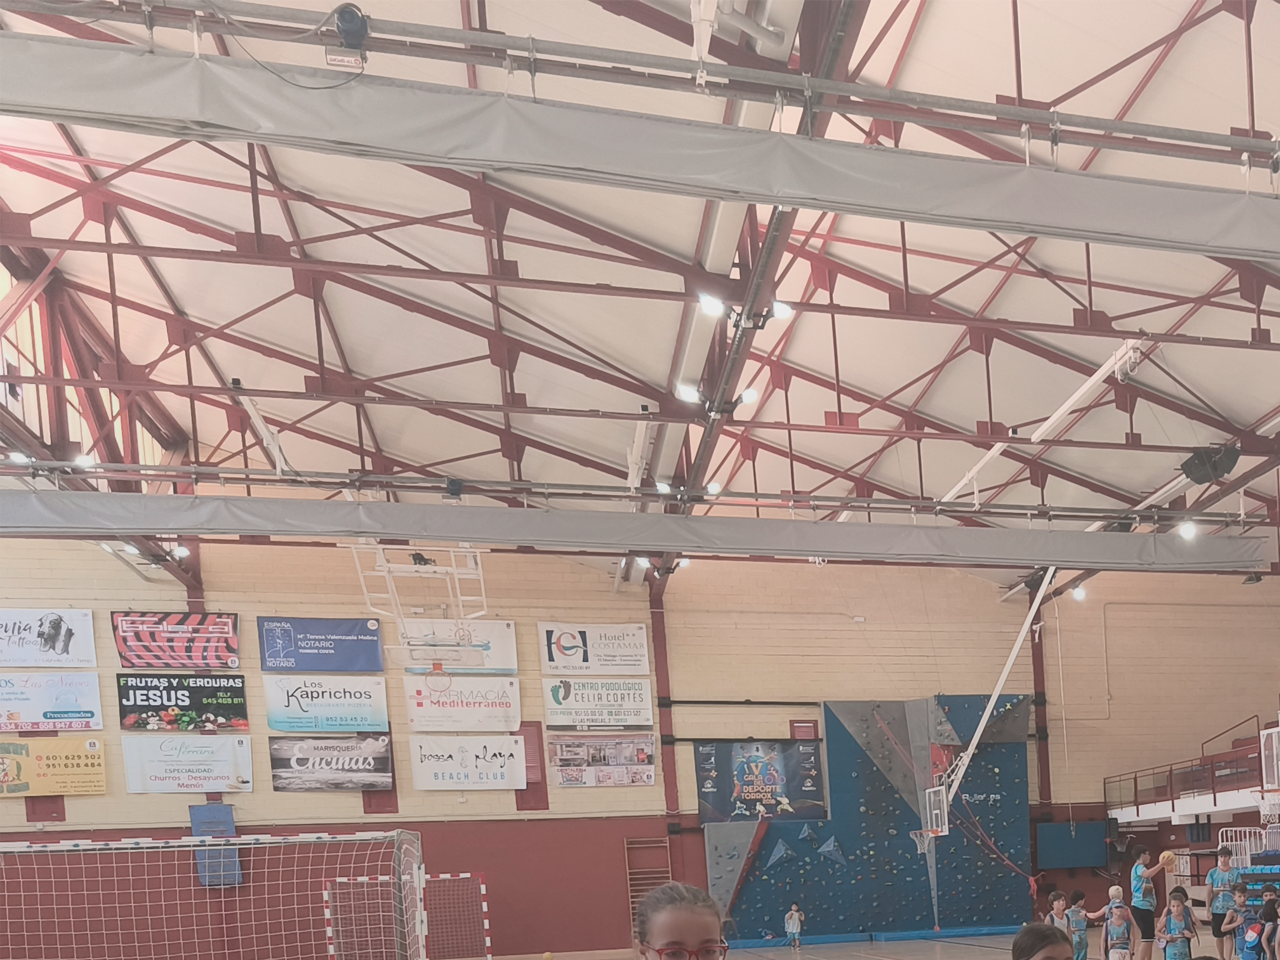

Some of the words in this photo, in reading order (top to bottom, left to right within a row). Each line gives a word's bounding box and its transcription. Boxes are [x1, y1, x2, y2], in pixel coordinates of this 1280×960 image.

[592, 642, 646, 650] COSTAMAR
[120, 677, 169, 688] FRUTAS
[171, 678, 179, 687] Y
[182, 678, 243, 688] VERDURAS
[303, 680, 324, 689] Los
[573, 682, 599, 691] CENTRO
[600, 680, 643, 692] PODOLÓGICO
[284, 686, 373, 713] Kaprichos
[429, 690, 511, 701] FARMACIA
[574, 692, 603, 703] CELIA
[606, 690, 644, 703] CORTÉS
[17, 722, 32, 730] 702
[39, 721, 54, 729] 658
[55, 721, 70, 729] 947
[289, 743, 375, 770] Encinas
[419, 744, 454, 763] bossa
[474, 745, 515, 769] playa
[750, 762, 763, 775] V
[187, 774, 230, 782] Desayunos
[434, 772, 470, 780] BEACH
[479, 772, 506, 780] CLUB
[743, 785, 782, 793] DEPORTE
[740, 792, 772, 800] TORROX
